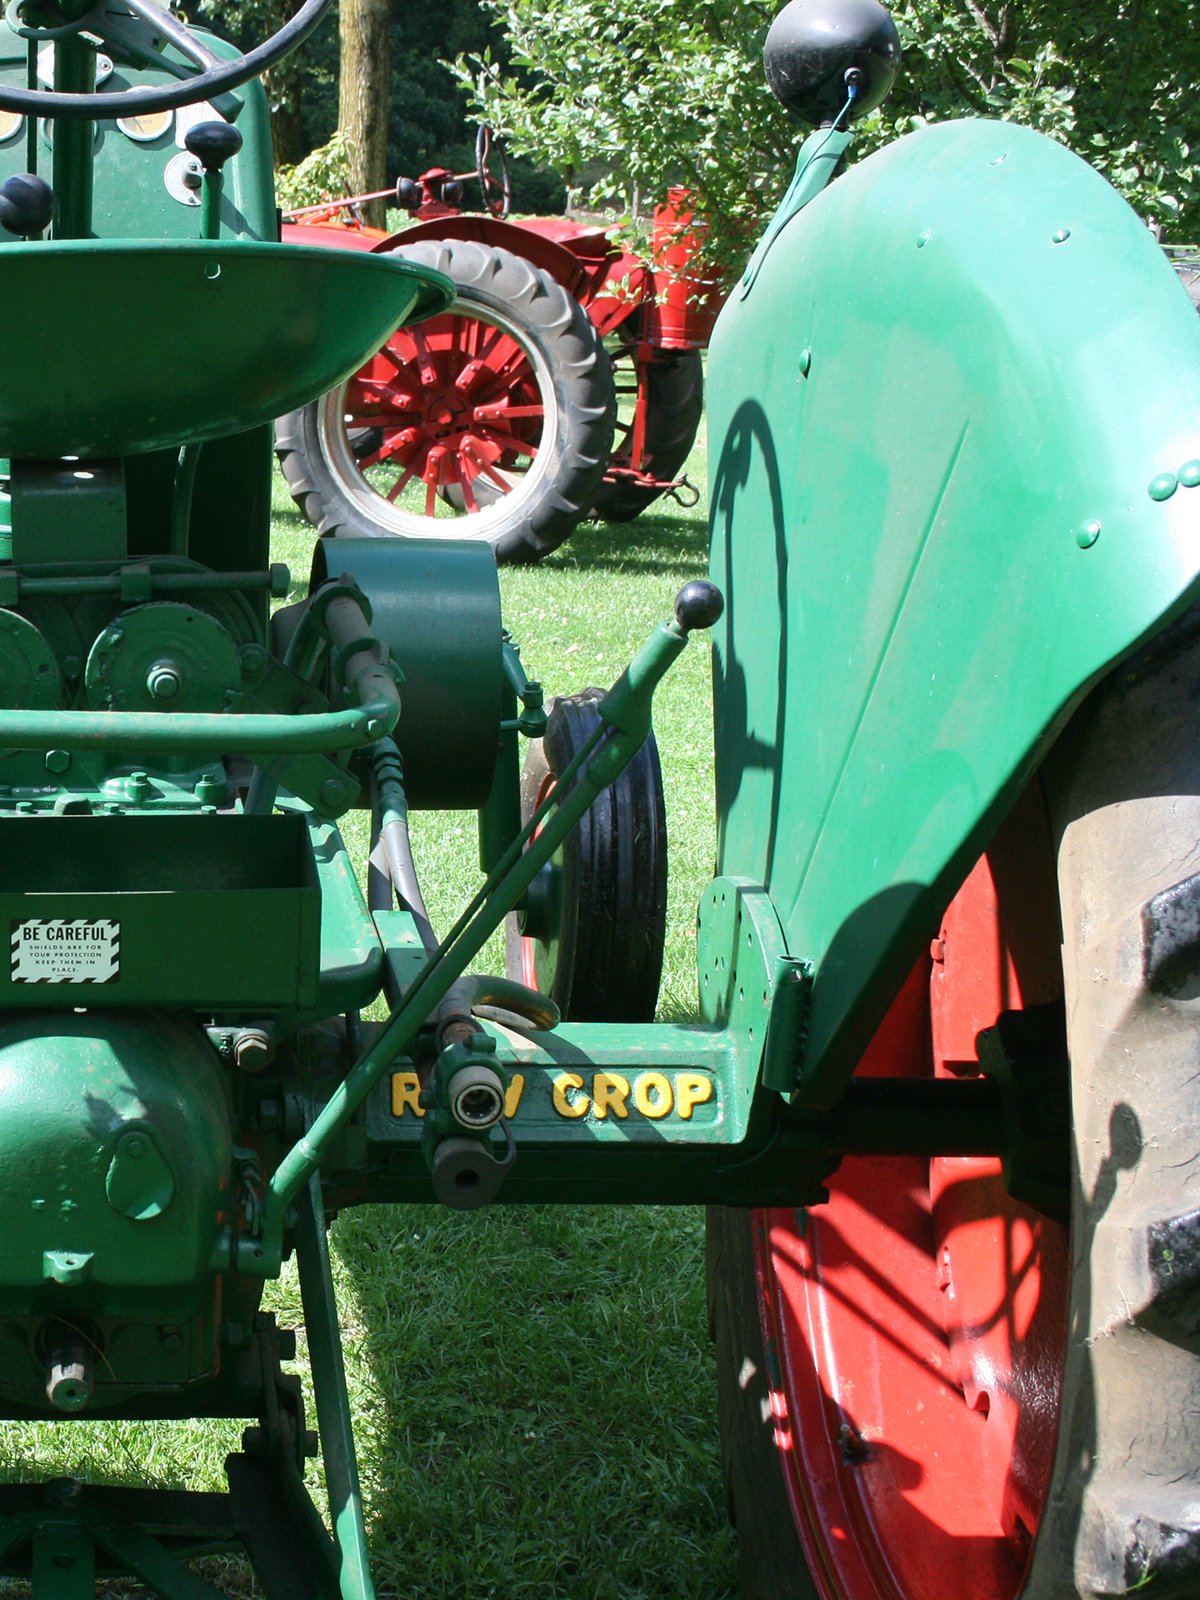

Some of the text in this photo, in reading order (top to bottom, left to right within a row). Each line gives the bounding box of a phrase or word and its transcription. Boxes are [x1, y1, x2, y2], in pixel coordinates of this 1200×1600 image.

[23, 927, 108, 941] BE CAREFUL
[552, 1072, 713, 1120] CROP
